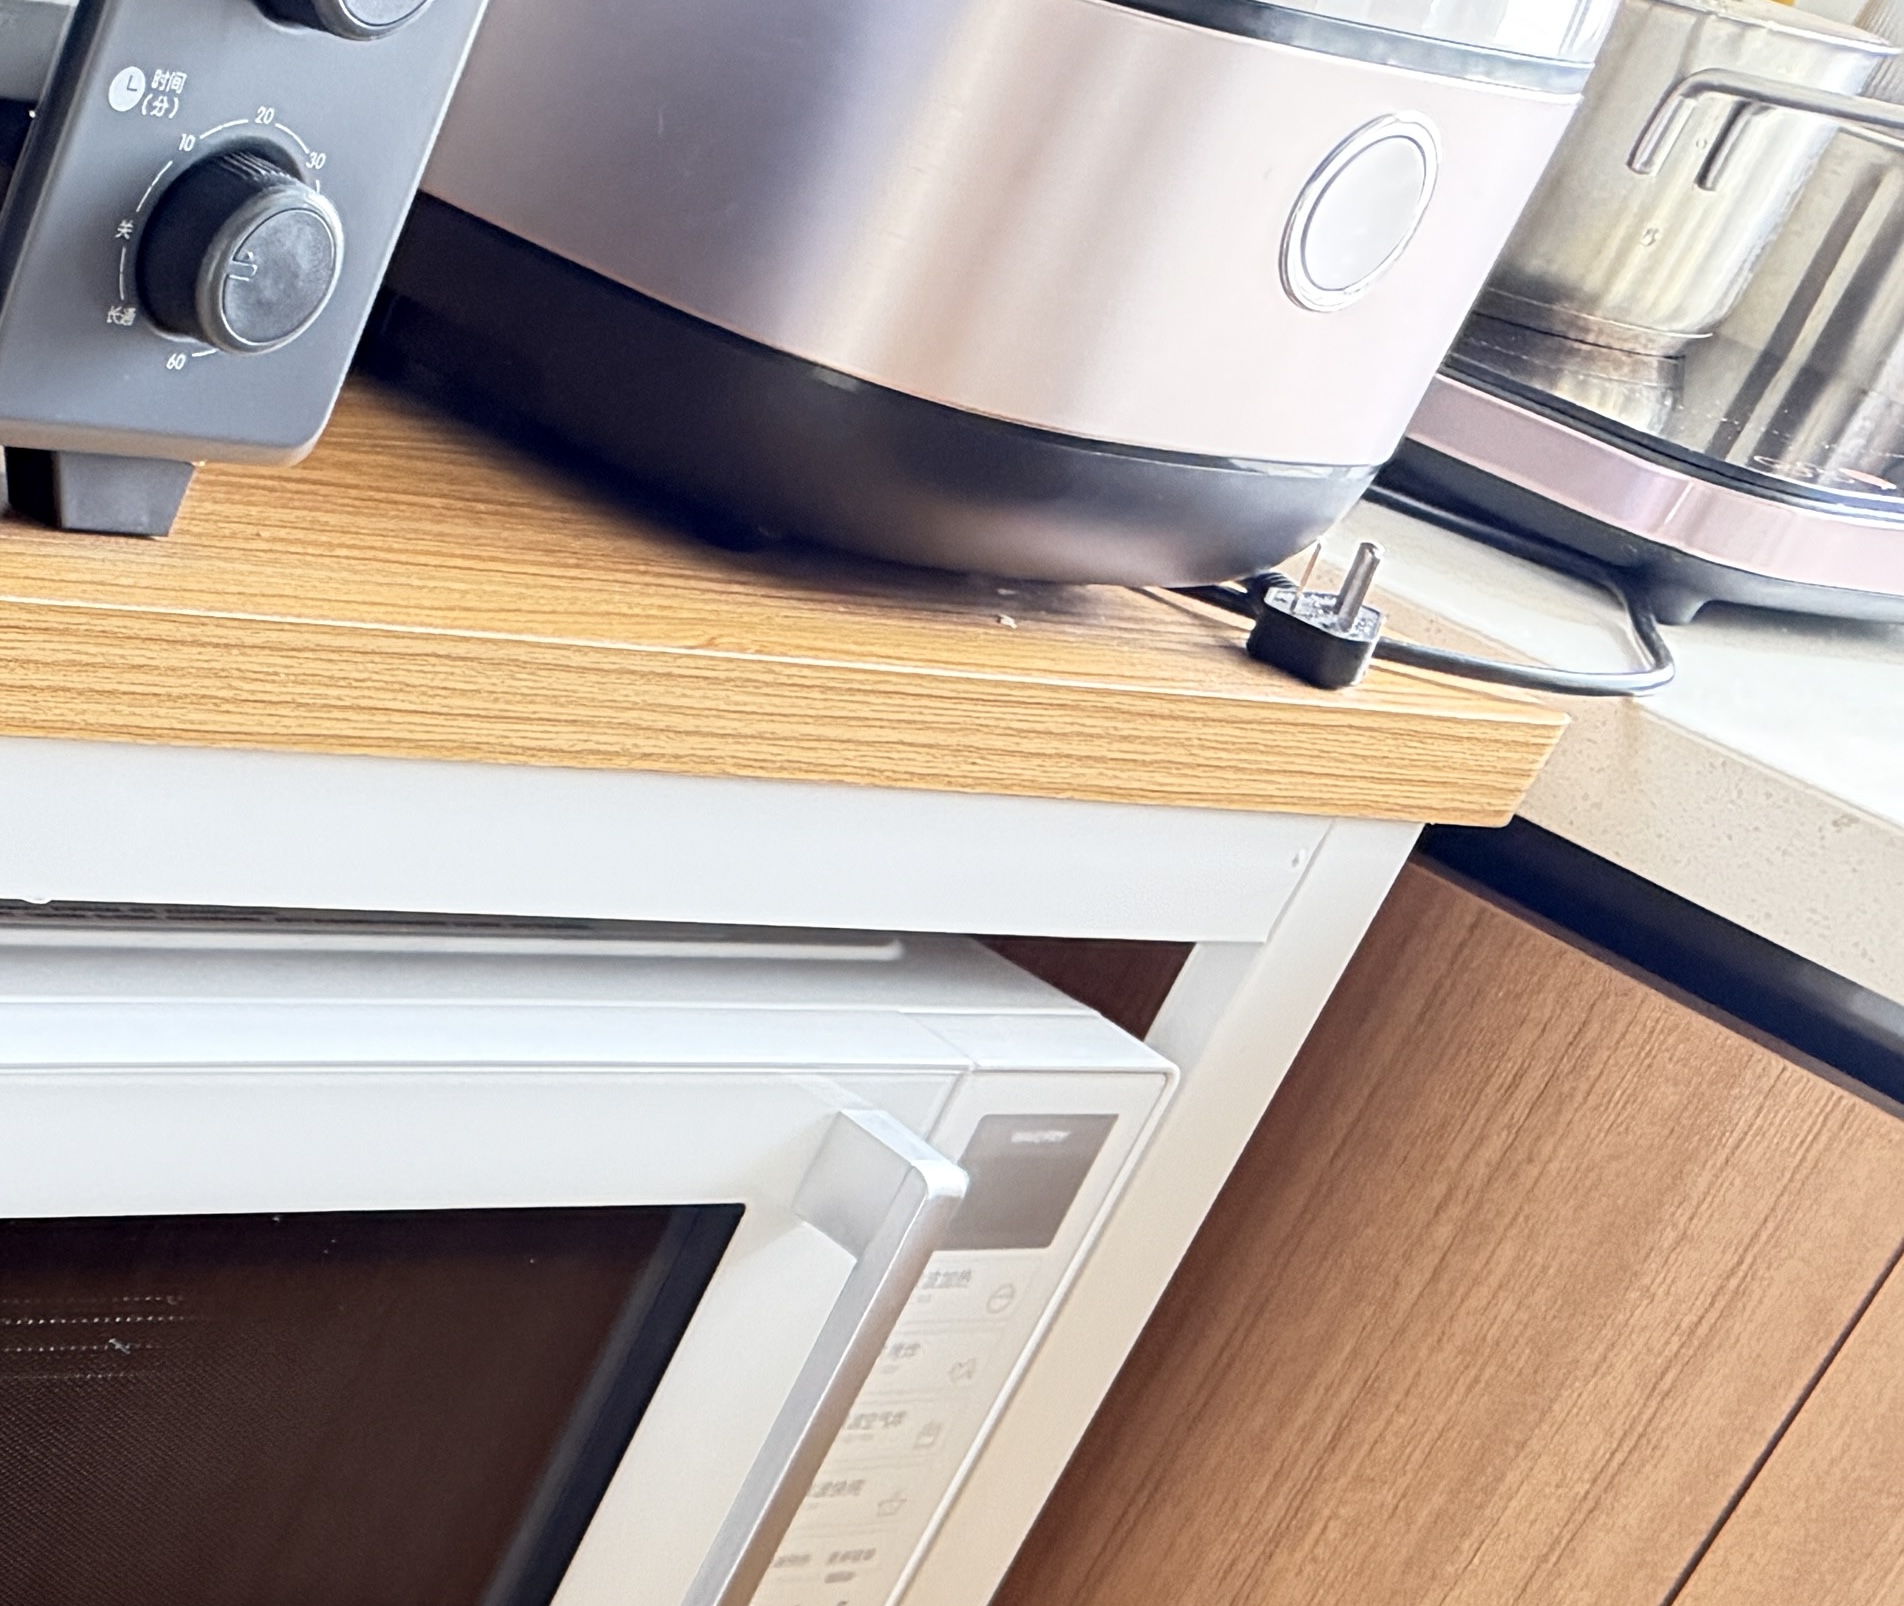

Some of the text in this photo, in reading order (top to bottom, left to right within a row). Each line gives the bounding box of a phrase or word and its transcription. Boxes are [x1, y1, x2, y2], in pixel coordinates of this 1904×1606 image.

[150, 68, 188, 94] 时间
[141, 94, 180, 119] (分)
[254, 106, 275, 125] 20
[178, 133, 197, 152] 10
[305, 152, 327, 170] 30
[114, 219, 134, 240] 关
[165, 352, 187, 371] 60
